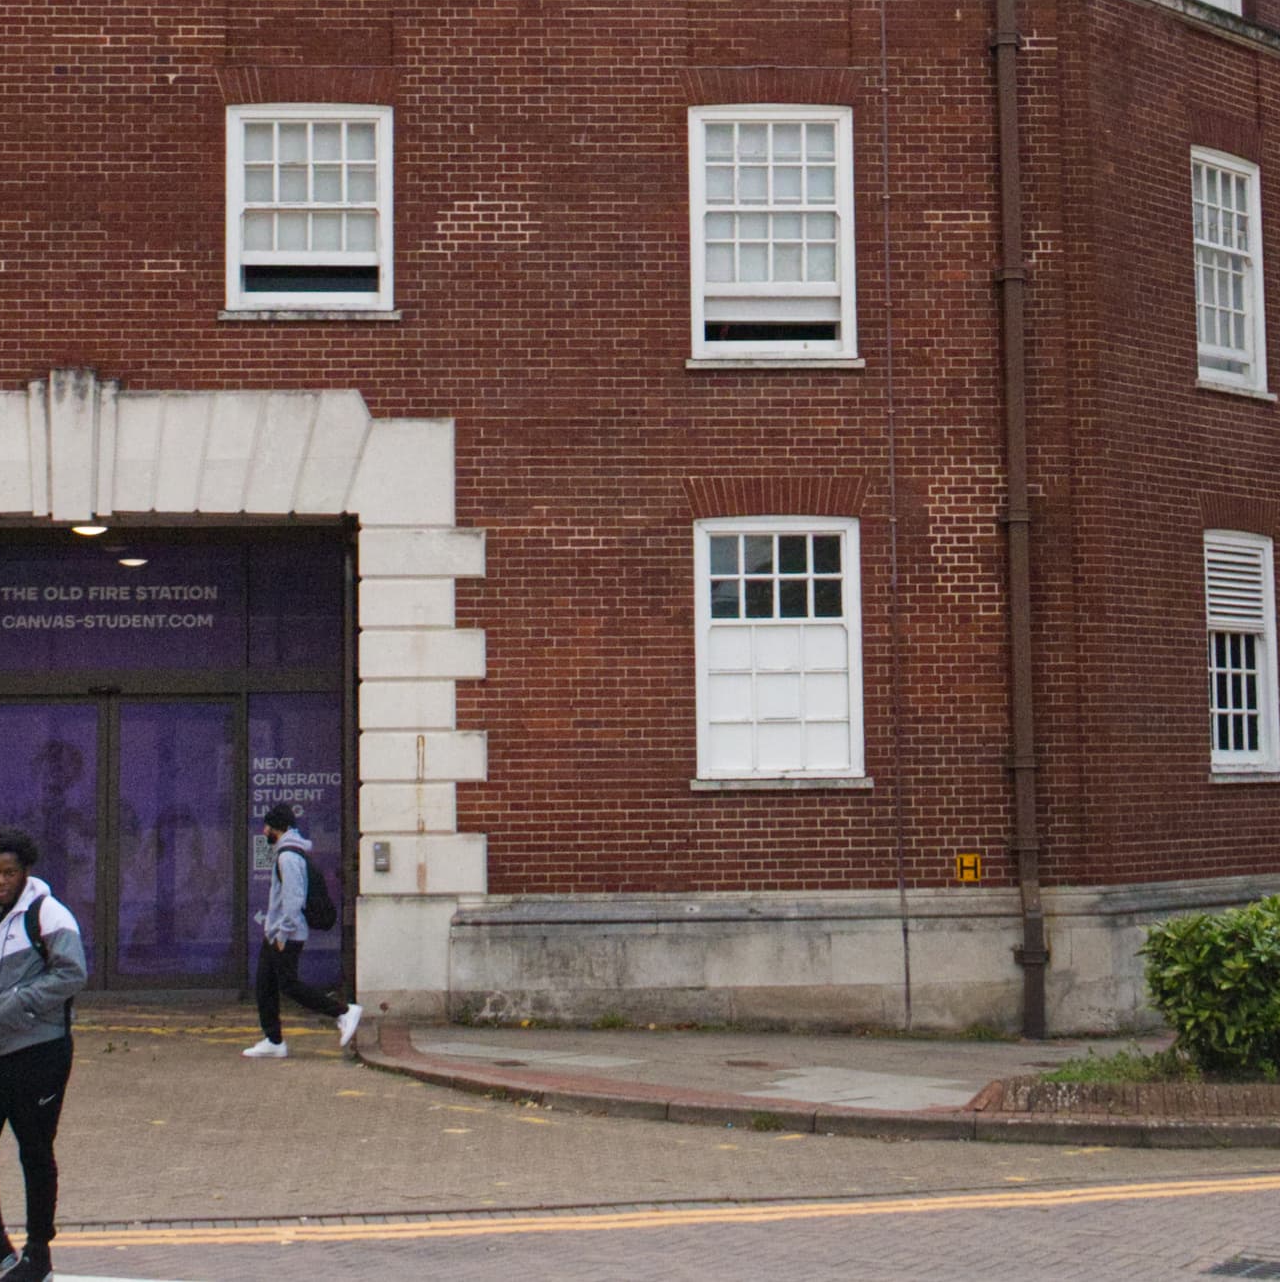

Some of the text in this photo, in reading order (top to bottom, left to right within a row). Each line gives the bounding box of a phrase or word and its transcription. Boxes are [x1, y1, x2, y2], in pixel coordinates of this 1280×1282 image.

[1, 585, 219, 601] THE OLD FIRE STATION
[1, 614, 214, 629] CANVAS-STUDENT.COM
[253, 757, 295, 770] NEXT
[253, 788, 325, 802] STUDENT
[960, 857, 978, 879] H
